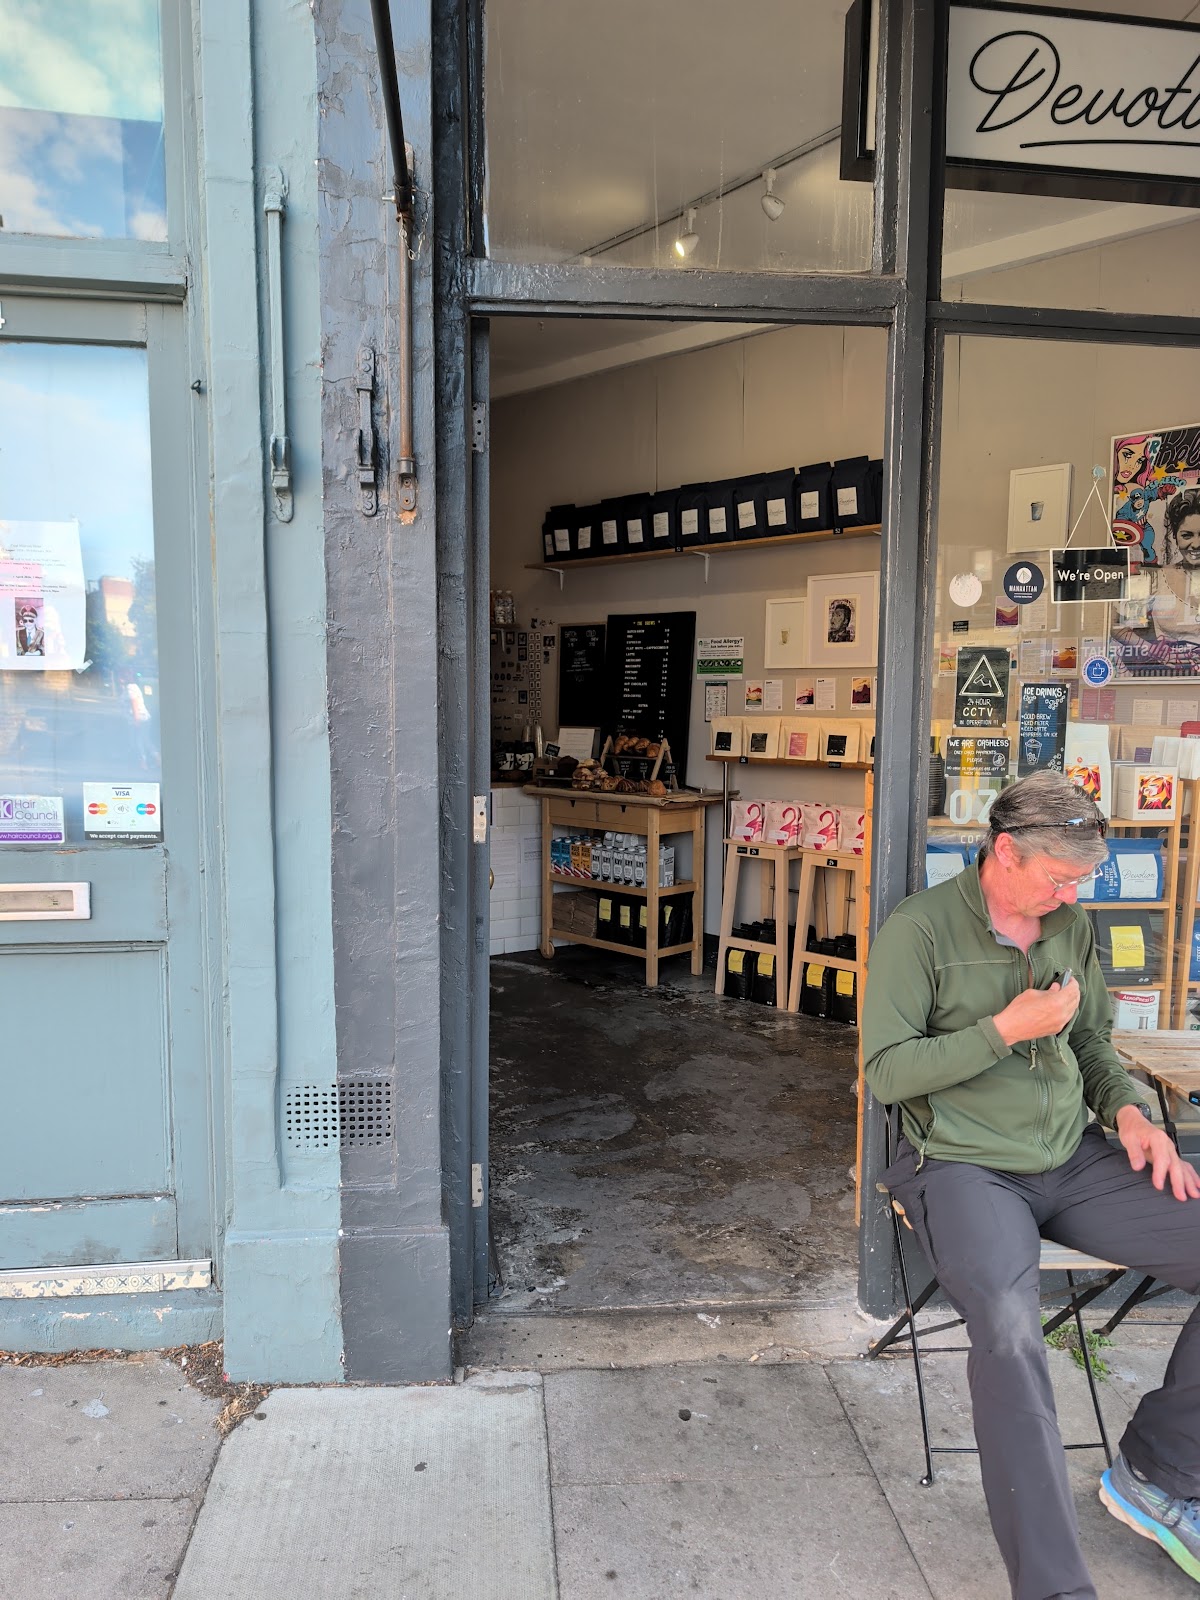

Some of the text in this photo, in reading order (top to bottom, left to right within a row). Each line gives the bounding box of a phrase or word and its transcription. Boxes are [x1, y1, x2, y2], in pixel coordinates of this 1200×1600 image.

[1057, 568, 1124, 583] We're Open
[1024, 687, 1062, 698] ICE DRINKS
[975, 698, 992, 706] HOUR
[962, 707, 993, 717] CCTV
[961, 739, 974, 749] ARE
[977, 739, 1009, 749] CASHLESS
[14, 800, 35, 808] Hair
[15, 811, 58, 820] Council
[1122, 869, 1156, 879] Devotion
[1115, 942, 1142, 950] Devotion
